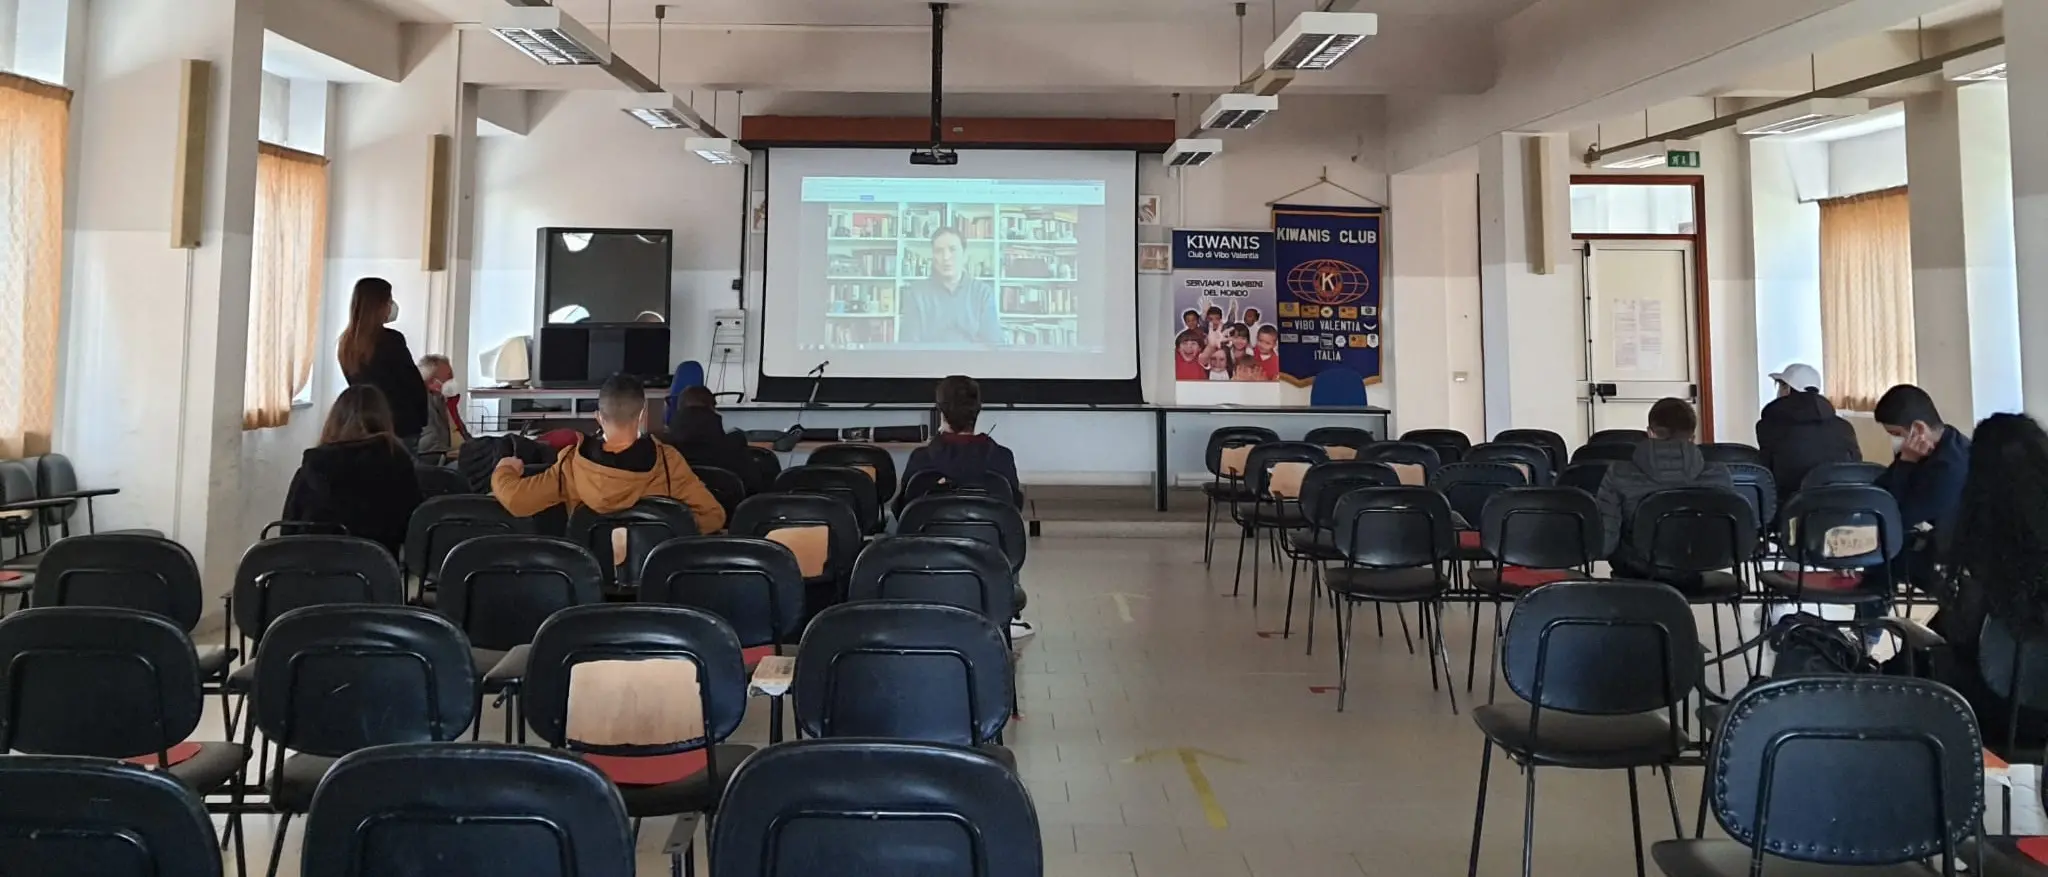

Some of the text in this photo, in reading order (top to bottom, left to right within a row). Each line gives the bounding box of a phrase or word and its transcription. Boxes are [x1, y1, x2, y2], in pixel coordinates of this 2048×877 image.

[1276, 227, 1377, 243] KIWANIS CLUB
[1186, 235, 1260, 250] KIWANIS
[1187, 250, 1259, 259] Club di Vibo Valentia
[1185, 280, 1225, 288] SERVIAMO
[1231, 280, 1264, 288] BAMBINI
[1321, 272, 1335, 291] K
[1203, 289, 1249, 297] DEL MONDO
[1294, 320, 1361, 331] VIBO VALENTIA
[1314, 350, 1342, 361] ITALIA
